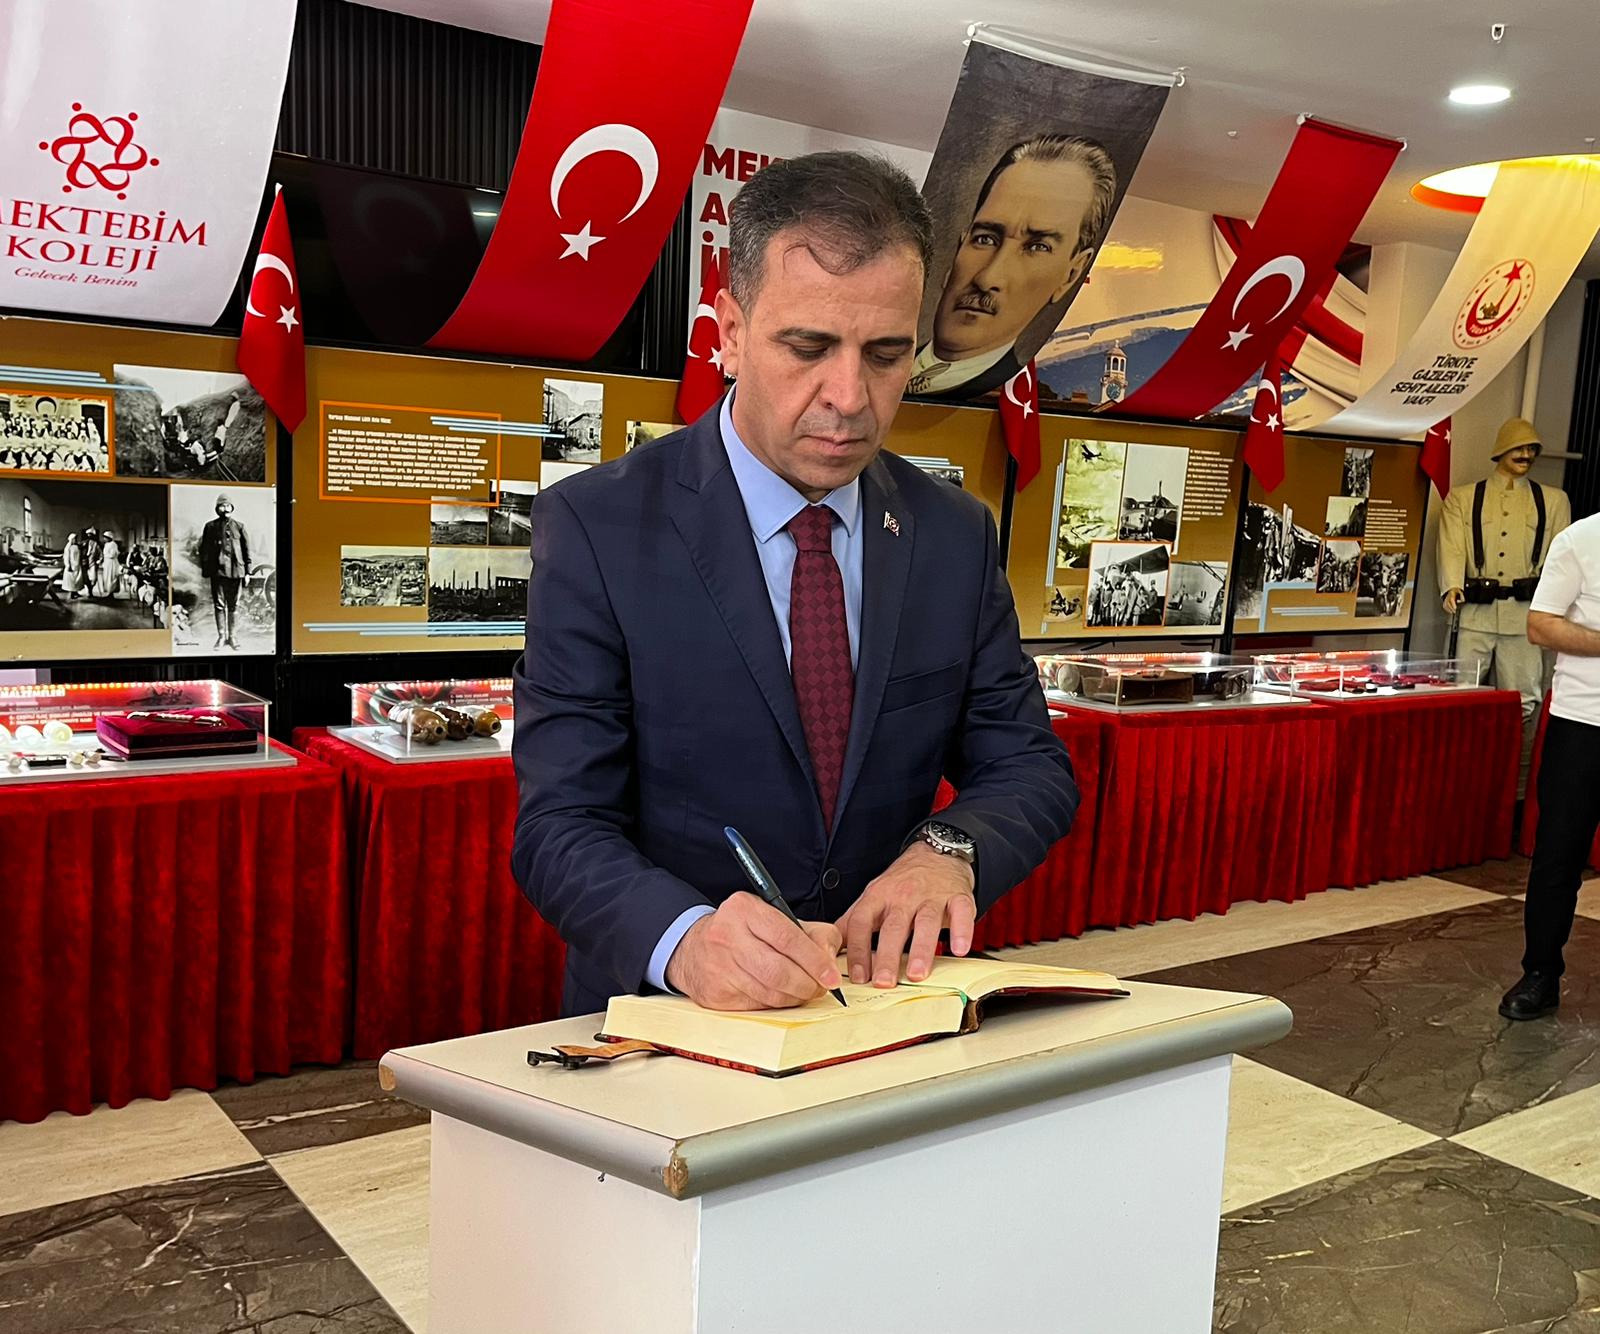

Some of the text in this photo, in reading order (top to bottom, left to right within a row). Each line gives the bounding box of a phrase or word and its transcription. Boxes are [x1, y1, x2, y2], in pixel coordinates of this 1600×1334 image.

[0, 199, 208, 246] EKTEBİM
[6, 235, 160, 274] KOLEJİ
[14, 266, 139, 288] Gelecek Benim
